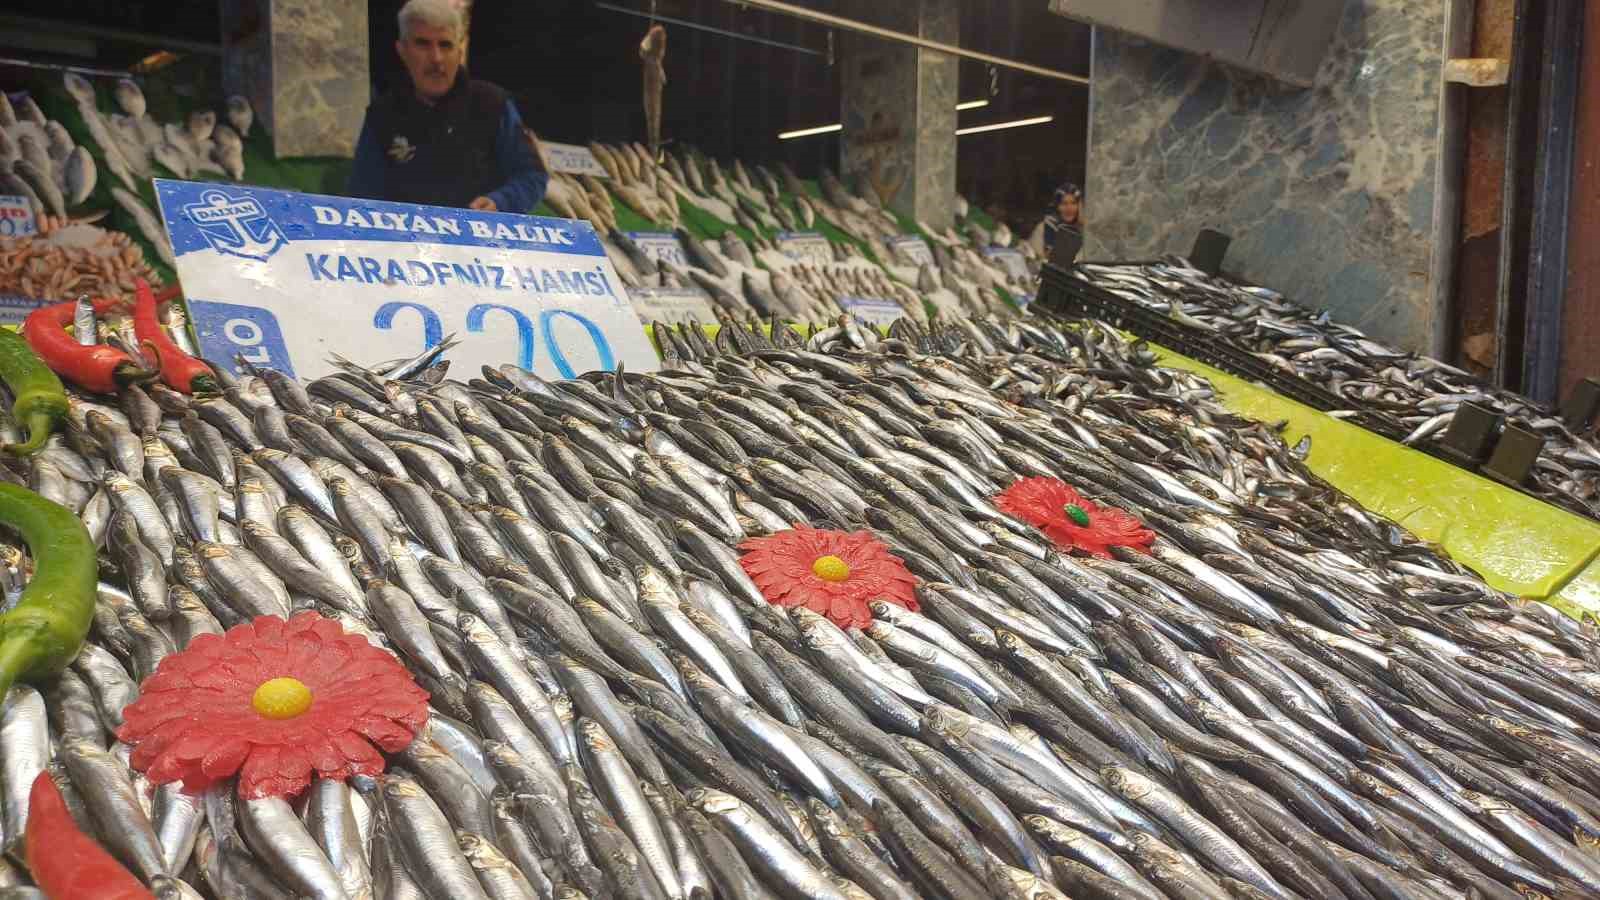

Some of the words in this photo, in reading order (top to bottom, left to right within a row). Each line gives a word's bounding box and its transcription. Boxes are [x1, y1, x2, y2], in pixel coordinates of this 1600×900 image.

[197, 203, 256, 219] DALYAN
[311, 205, 463, 236] DALYAN
[467, 219, 573, 246] BALIK
[513, 265, 620, 298] HAMSİ
